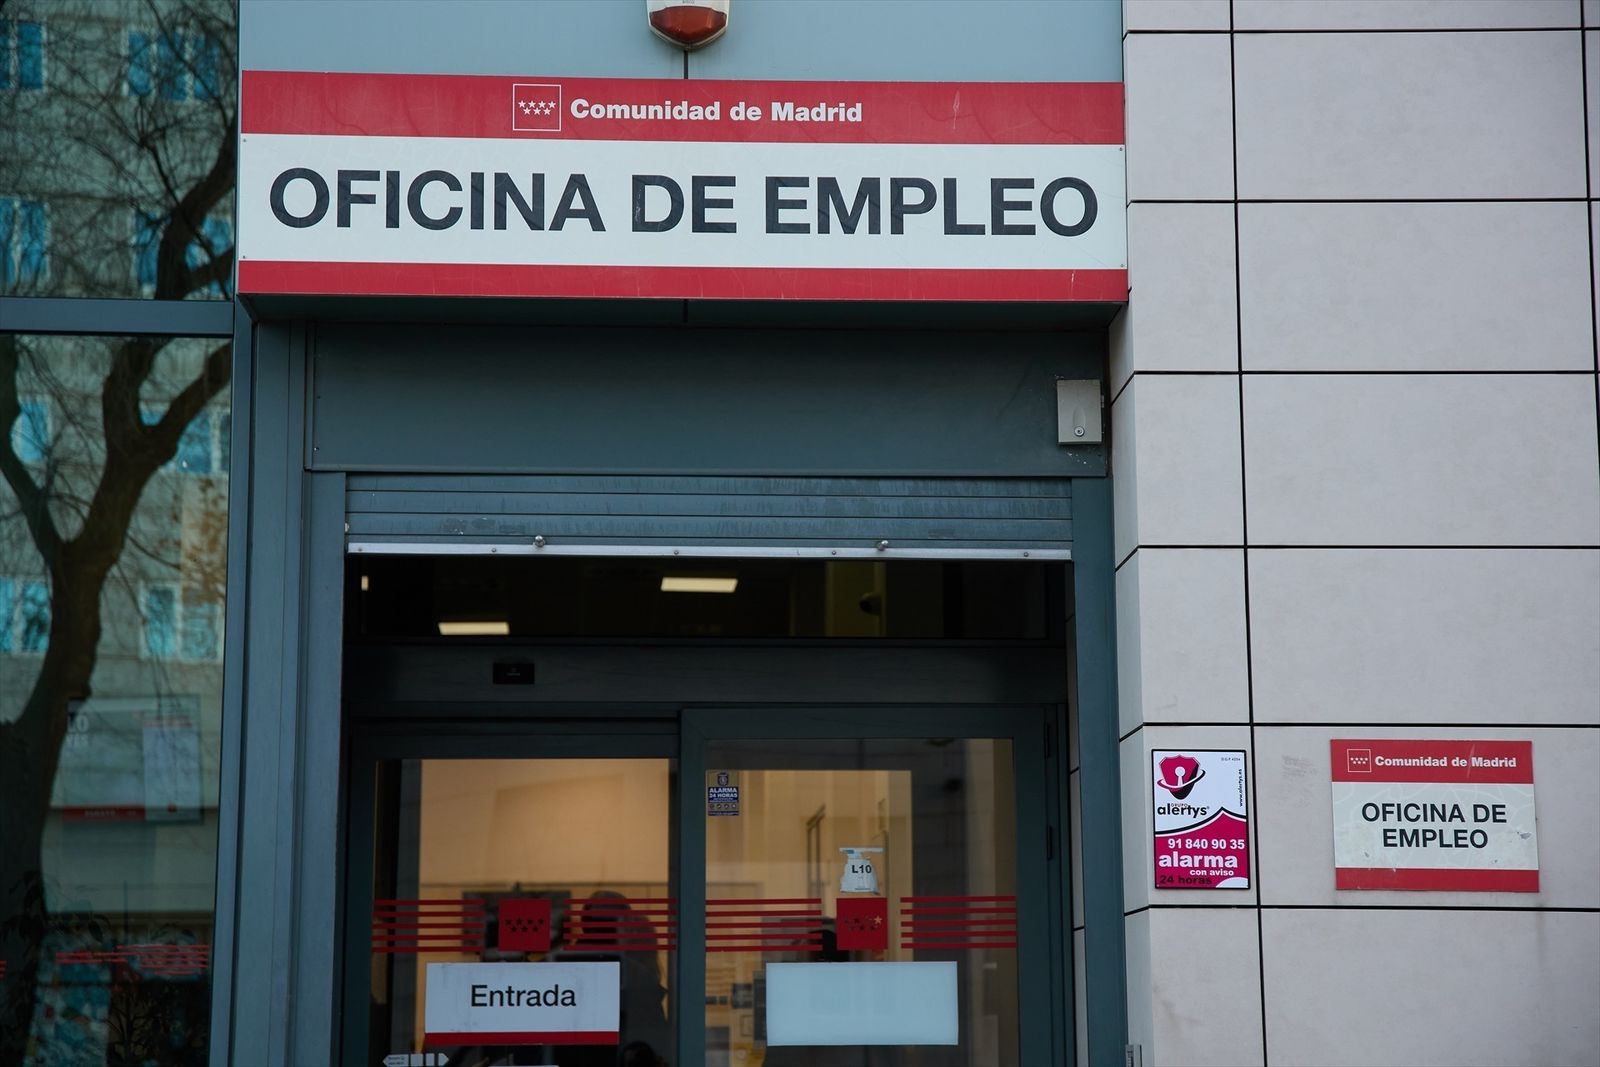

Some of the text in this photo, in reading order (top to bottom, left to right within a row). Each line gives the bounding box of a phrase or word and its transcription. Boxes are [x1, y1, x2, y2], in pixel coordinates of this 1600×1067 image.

[570, 98, 863, 123] Comunidad de Madrid
[269, 166, 1098, 237] OFICINA DE EMPLEO
[1375, 756, 1517, 768] Comunidad de Madrid
[1157, 803, 1208, 818] alertys
[1361, 802, 1507, 823] OFICINA DE
[1168, 838, 1245, 850] 91 840 90 35
[1383, 828, 1489, 849] EMPLEO
[1158, 851, 1238, 868] alarma
[851, 864, 872, 874] L10
[1160, 875, 1213, 885] 24 horas
[470, 984, 577, 1007] Entrada
